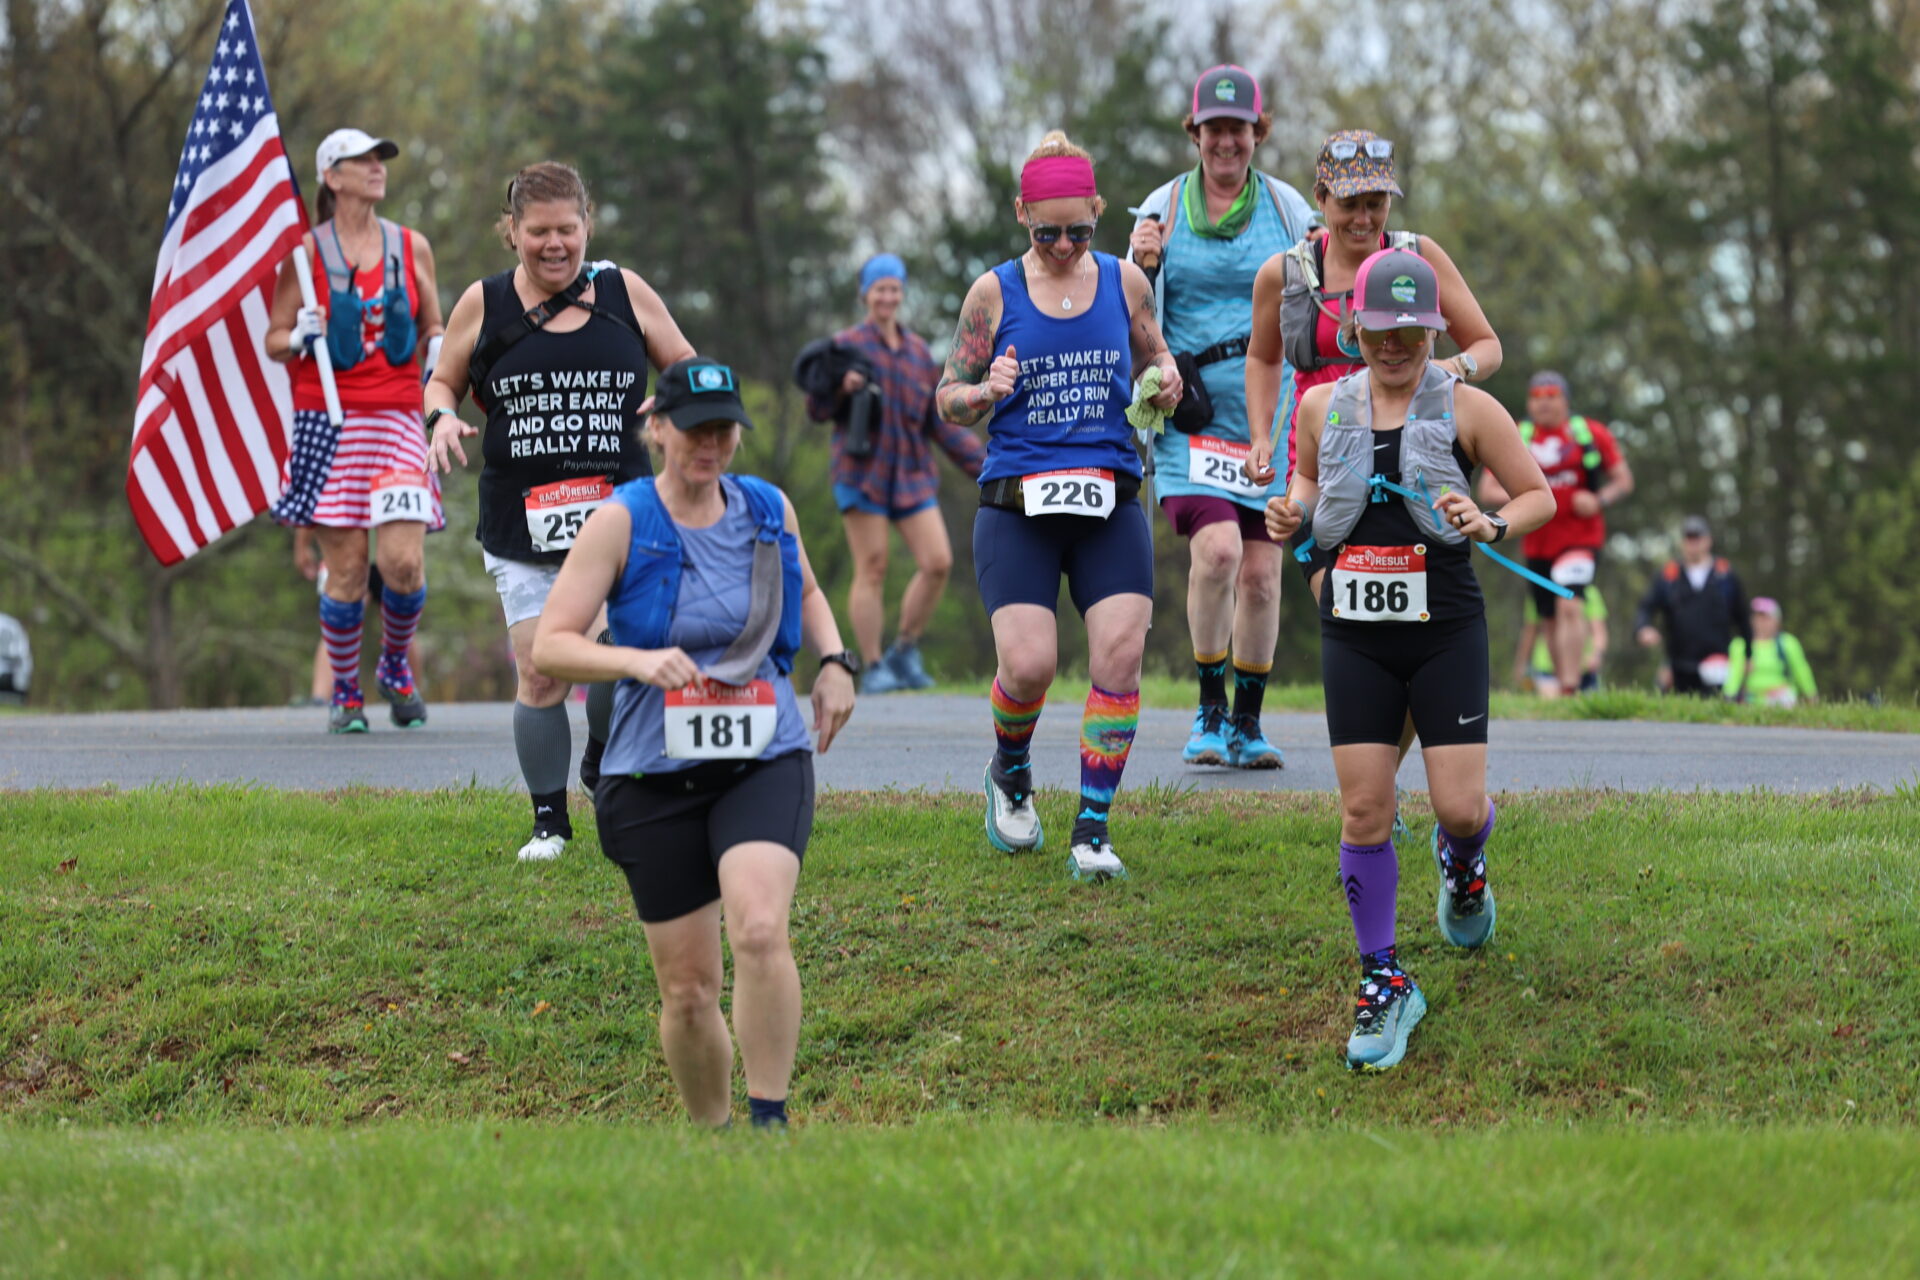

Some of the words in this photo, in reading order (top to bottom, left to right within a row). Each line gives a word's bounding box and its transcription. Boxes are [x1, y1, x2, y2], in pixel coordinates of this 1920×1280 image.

[1060, 350, 1101, 368] WAKE
[1105, 350, 1120, 365] UP
[492, 372, 544, 397] LET'S
[550, 371, 612, 389] WAKE
[616, 371, 635, 389] UP
[1023, 371, 1067, 391] SUPER
[1071, 368, 1113, 384] EARLY
[504, 393, 563, 415] SUPER
[569, 392, 625, 410] EARLY
[1027, 391, 1055, 408] AND
[1060, 387, 1081, 404] GO
[1084, 386, 1110, 401] RUN
[508, 416, 545, 437] AND
[550, 414, 583, 432] GO
[589, 413, 623, 432] RUN
[1027, 405, 1080, 425] REALLY
[1083, 404, 1105, 419] FAR
[511, 435, 581, 458] REALLY
[587, 434, 621, 453] FAR
[382, 491, 421, 513] 241
[1041, 481, 1103, 508] 226
[543, 507, 597, 543] 25
[1375, 555, 1409, 566] RESULT
[1346, 578, 1409, 613] 186
[687, 714, 751, 748] 181
